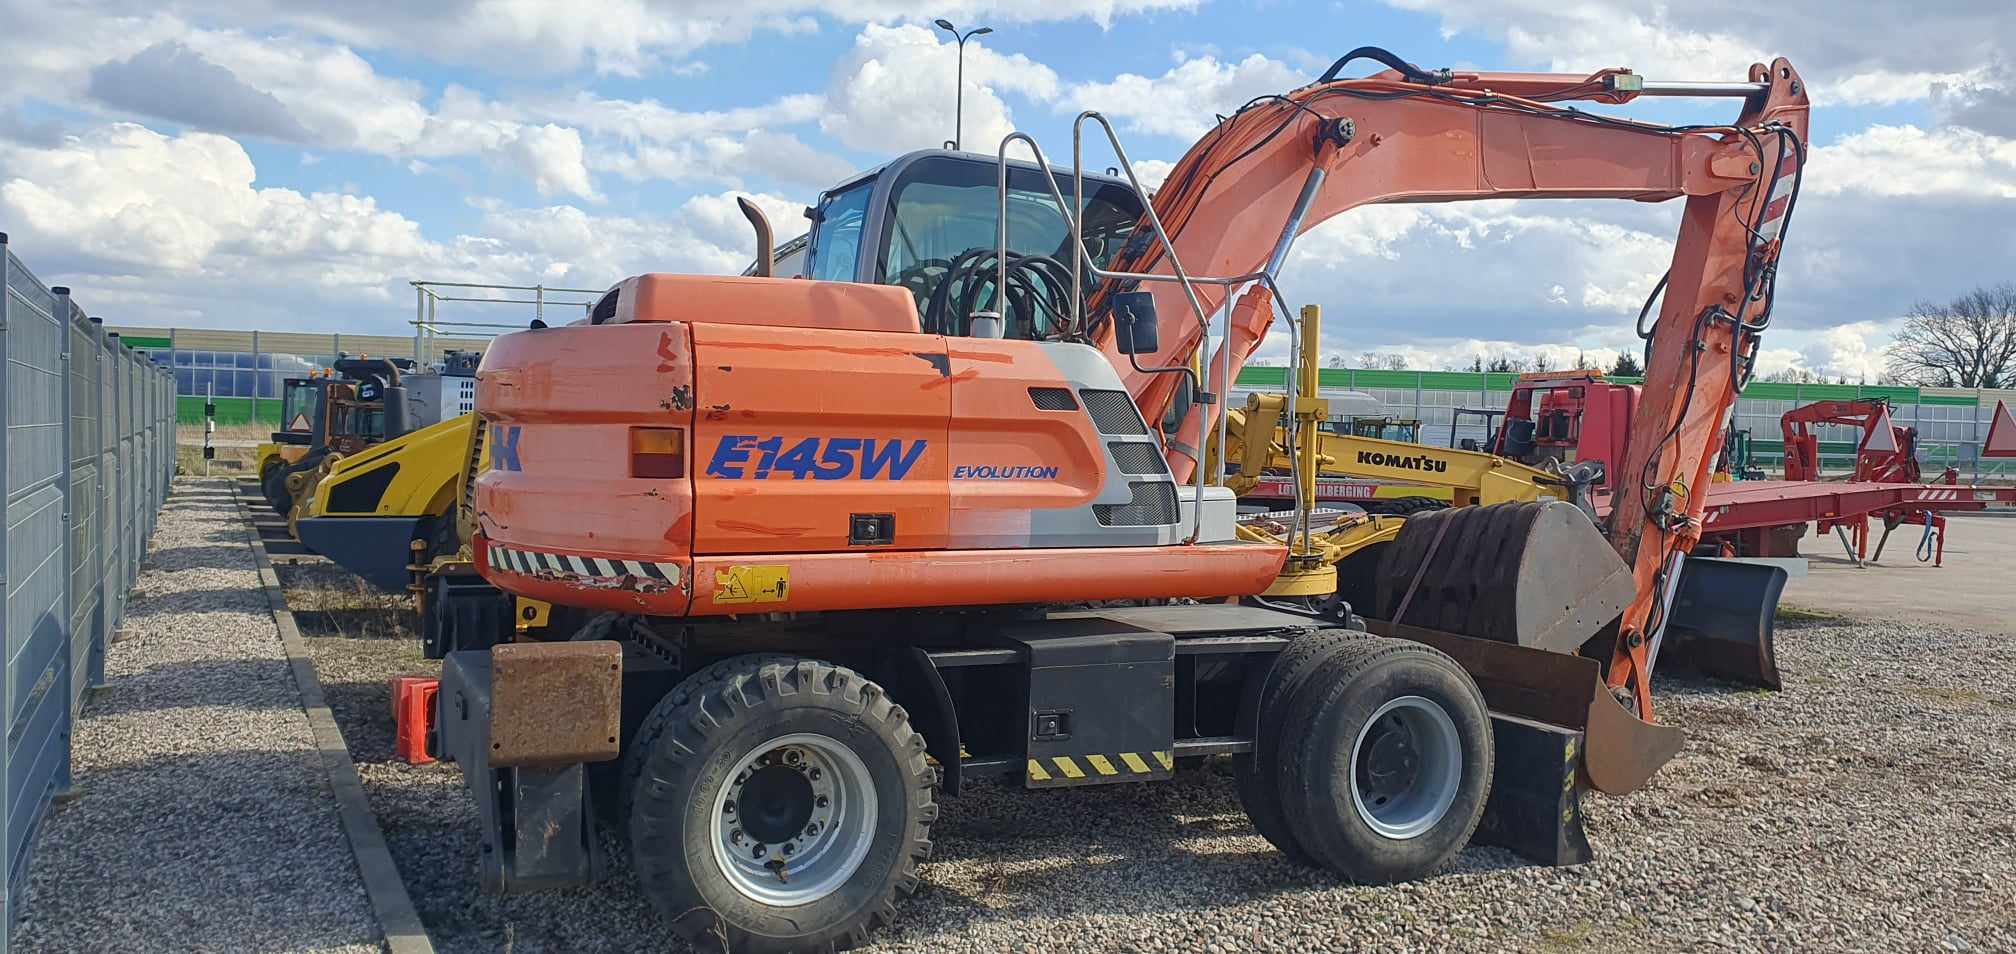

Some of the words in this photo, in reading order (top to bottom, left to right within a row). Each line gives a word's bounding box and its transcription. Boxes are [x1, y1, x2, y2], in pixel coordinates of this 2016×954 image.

[705, 435, 928, 480] E145W
[1357, 451, 1447, 473] KOMATSU
[953, 466, 1058, 479] EVOLUTION
